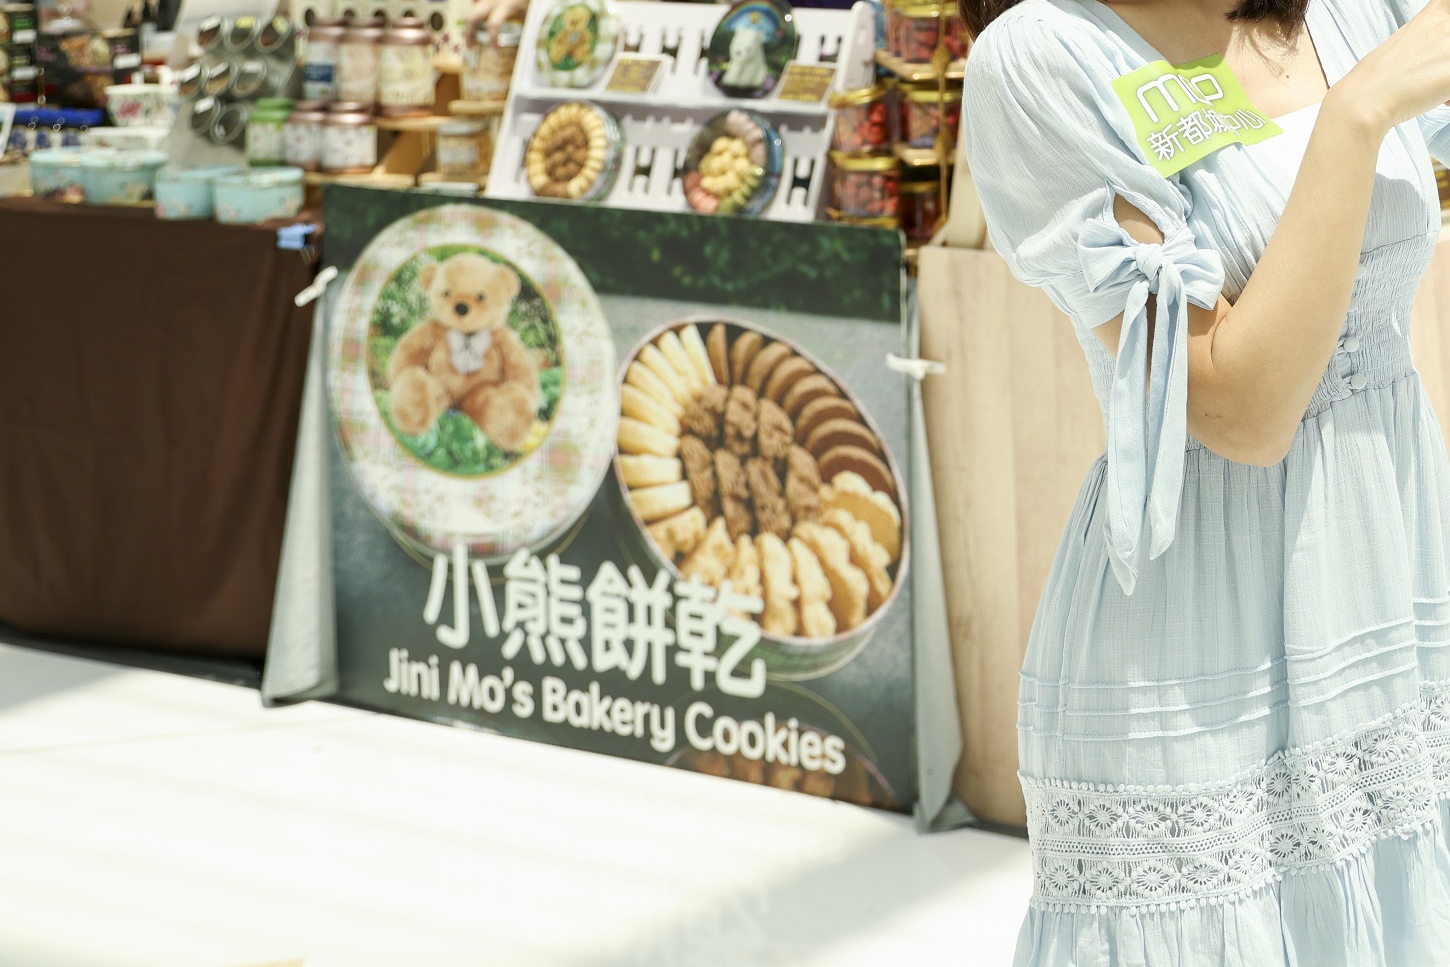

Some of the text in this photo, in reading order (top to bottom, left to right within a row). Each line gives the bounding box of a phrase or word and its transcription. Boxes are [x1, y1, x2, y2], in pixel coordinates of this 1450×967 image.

[423, 539, 766, 698] 小熊餅乾
[384, 647, 847, 775] Jini Mo's Bakery Cookies
